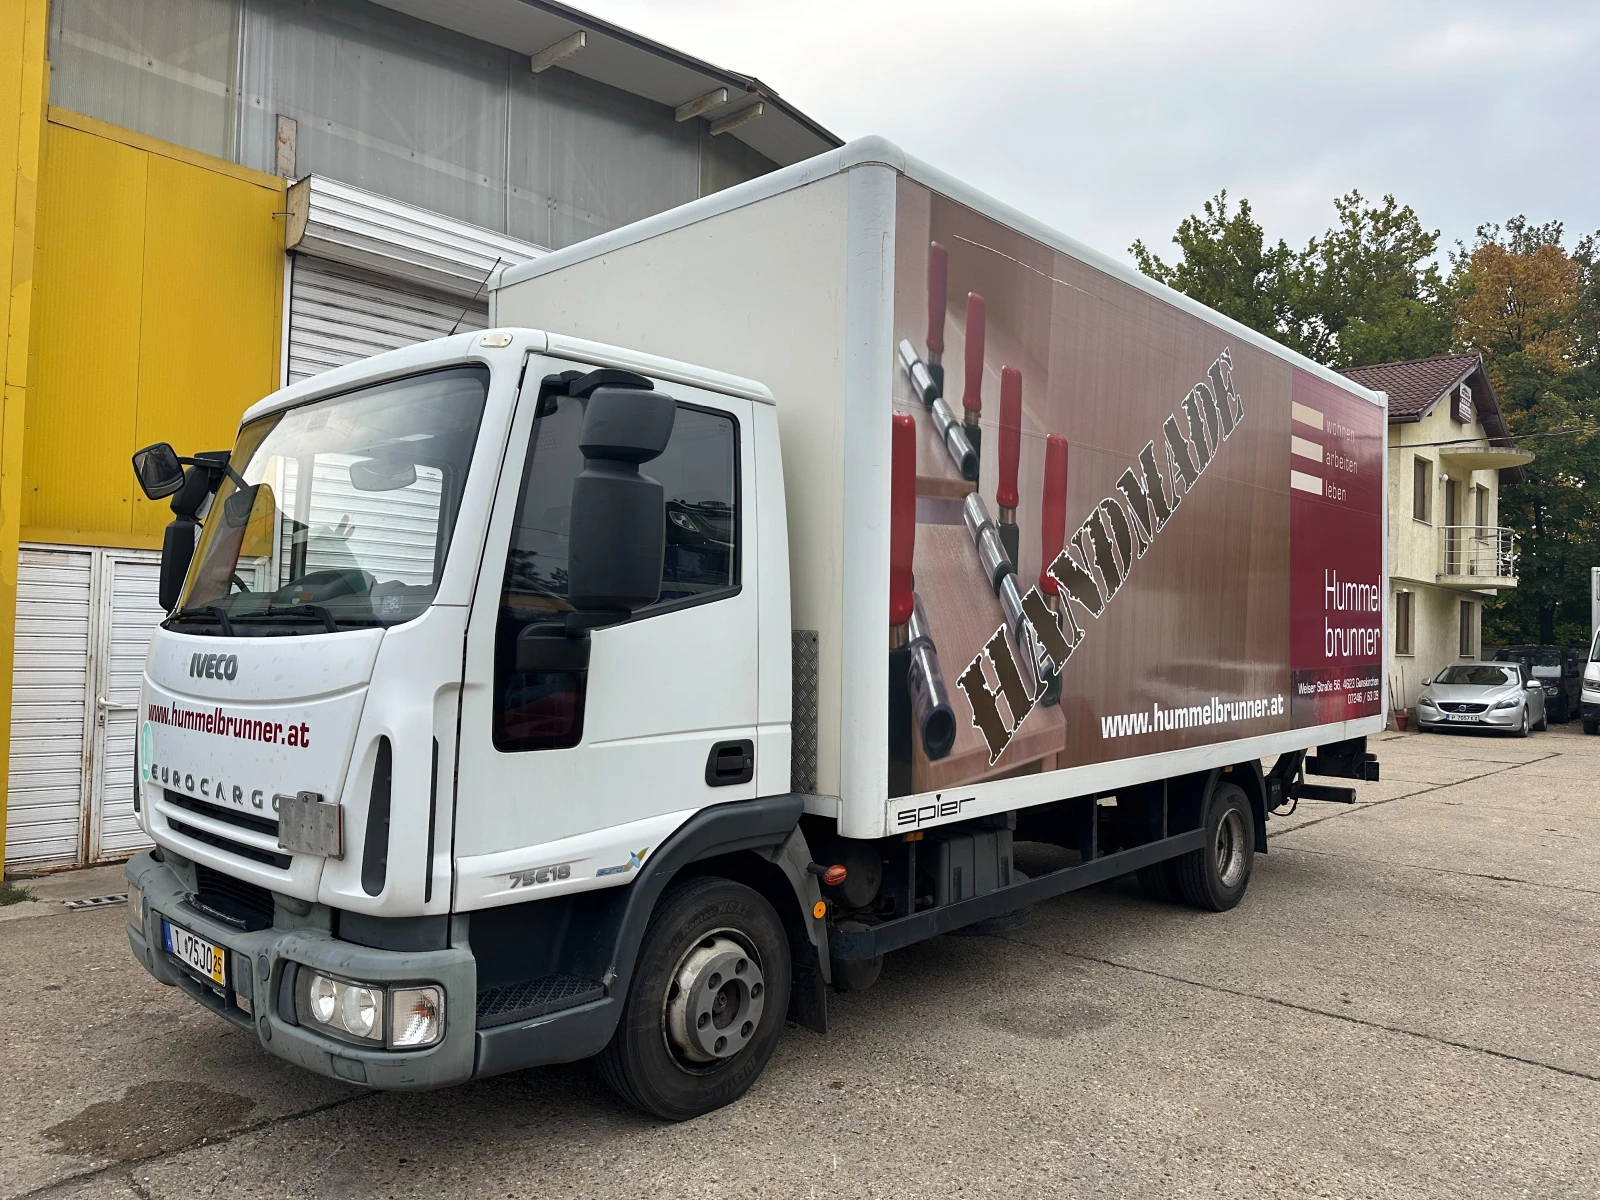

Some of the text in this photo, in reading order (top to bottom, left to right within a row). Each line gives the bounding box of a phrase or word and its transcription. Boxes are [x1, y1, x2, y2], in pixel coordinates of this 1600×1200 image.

[1326, 419, 1355, 442] wohnen
[1325, 450, 1358, 474] arbeiten
[1325, 479, 1347, 501] leben
[955, 345, 1245, 766] HANDMADE
[1325, 568, 1381, 612] Hummel
[1325, 616, 1380, 657] brunner
[189, 652, 239, 680] IVECO
[148, 701, 310, 748] www.hummelbrunner.at
[1101, 695, 1284, 739] www.hummelbrunner.at
[897, 794, 976, 827] spier
[509, 864, 571, 889] 75E18
[213, 954, 222, 975] 25
